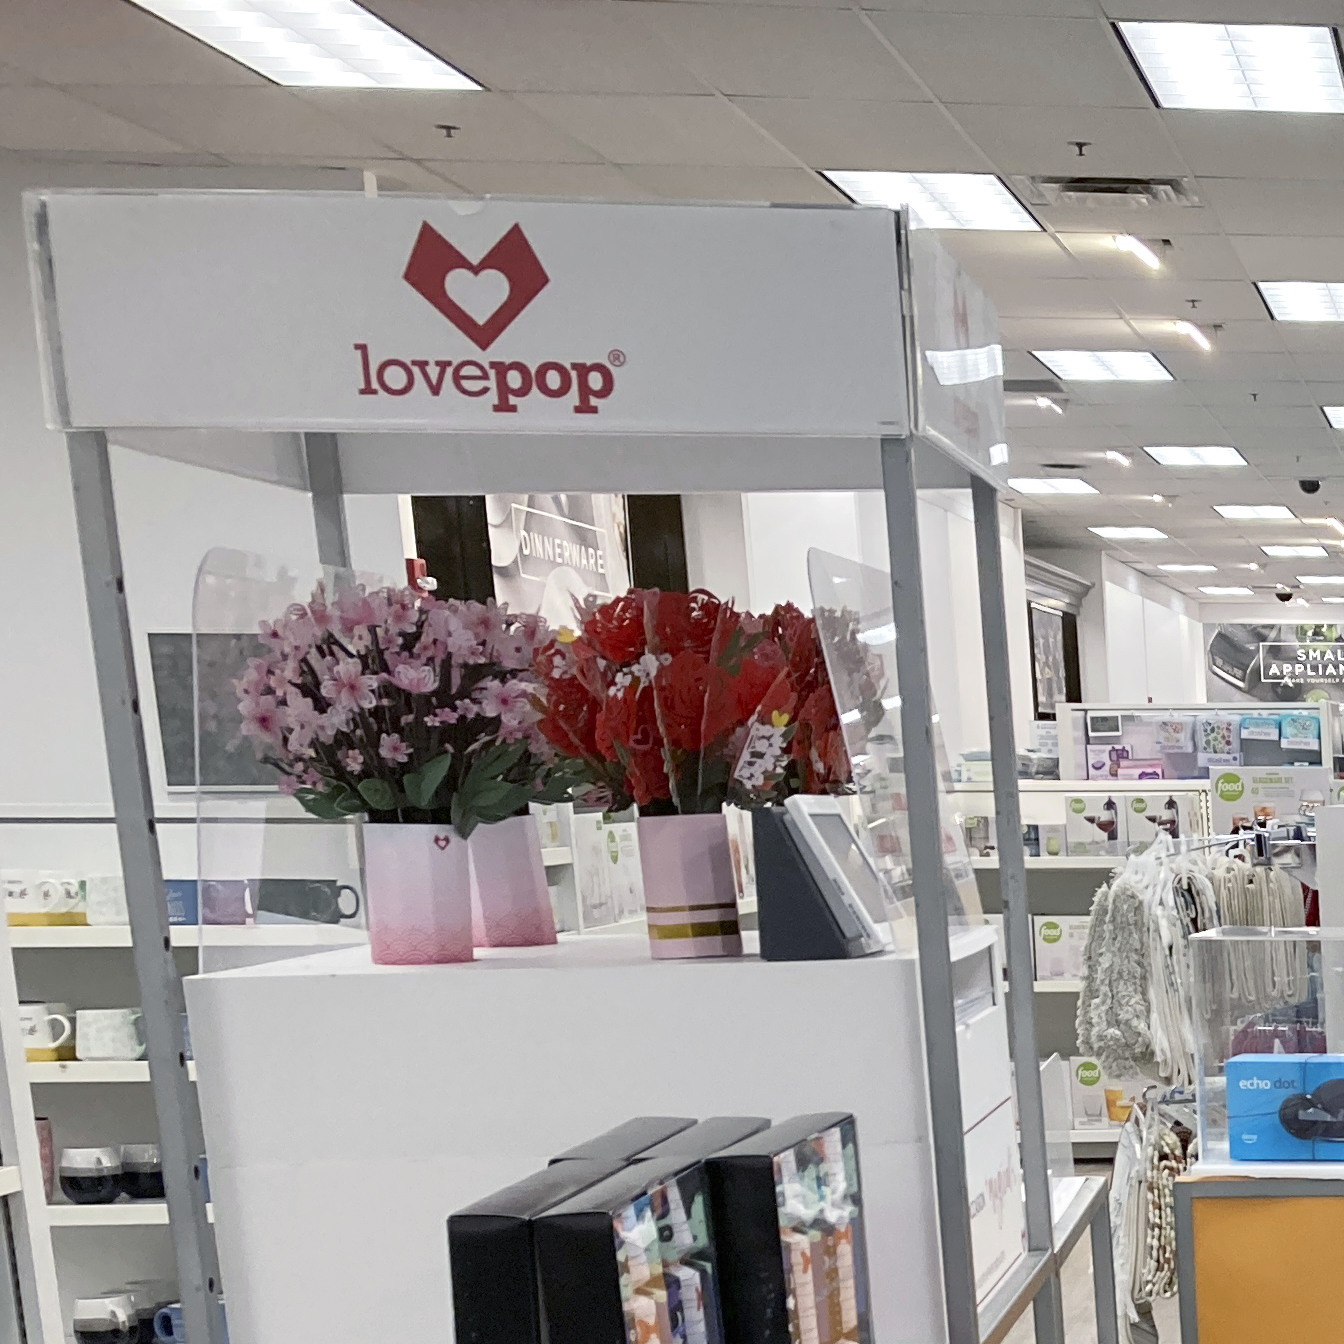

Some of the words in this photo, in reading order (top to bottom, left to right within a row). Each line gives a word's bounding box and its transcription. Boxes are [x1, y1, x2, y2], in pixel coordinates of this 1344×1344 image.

[354, 343, 614, 414] lovepop
[520, 529, 605, 574] DINNERWARE
[1217, 779, 1243, 794] food
[1078, 1066, 1100, 1081] food
[1239, 1077, 1271, 1089] echo
[1273, 1078, 1297, 1089] dot
